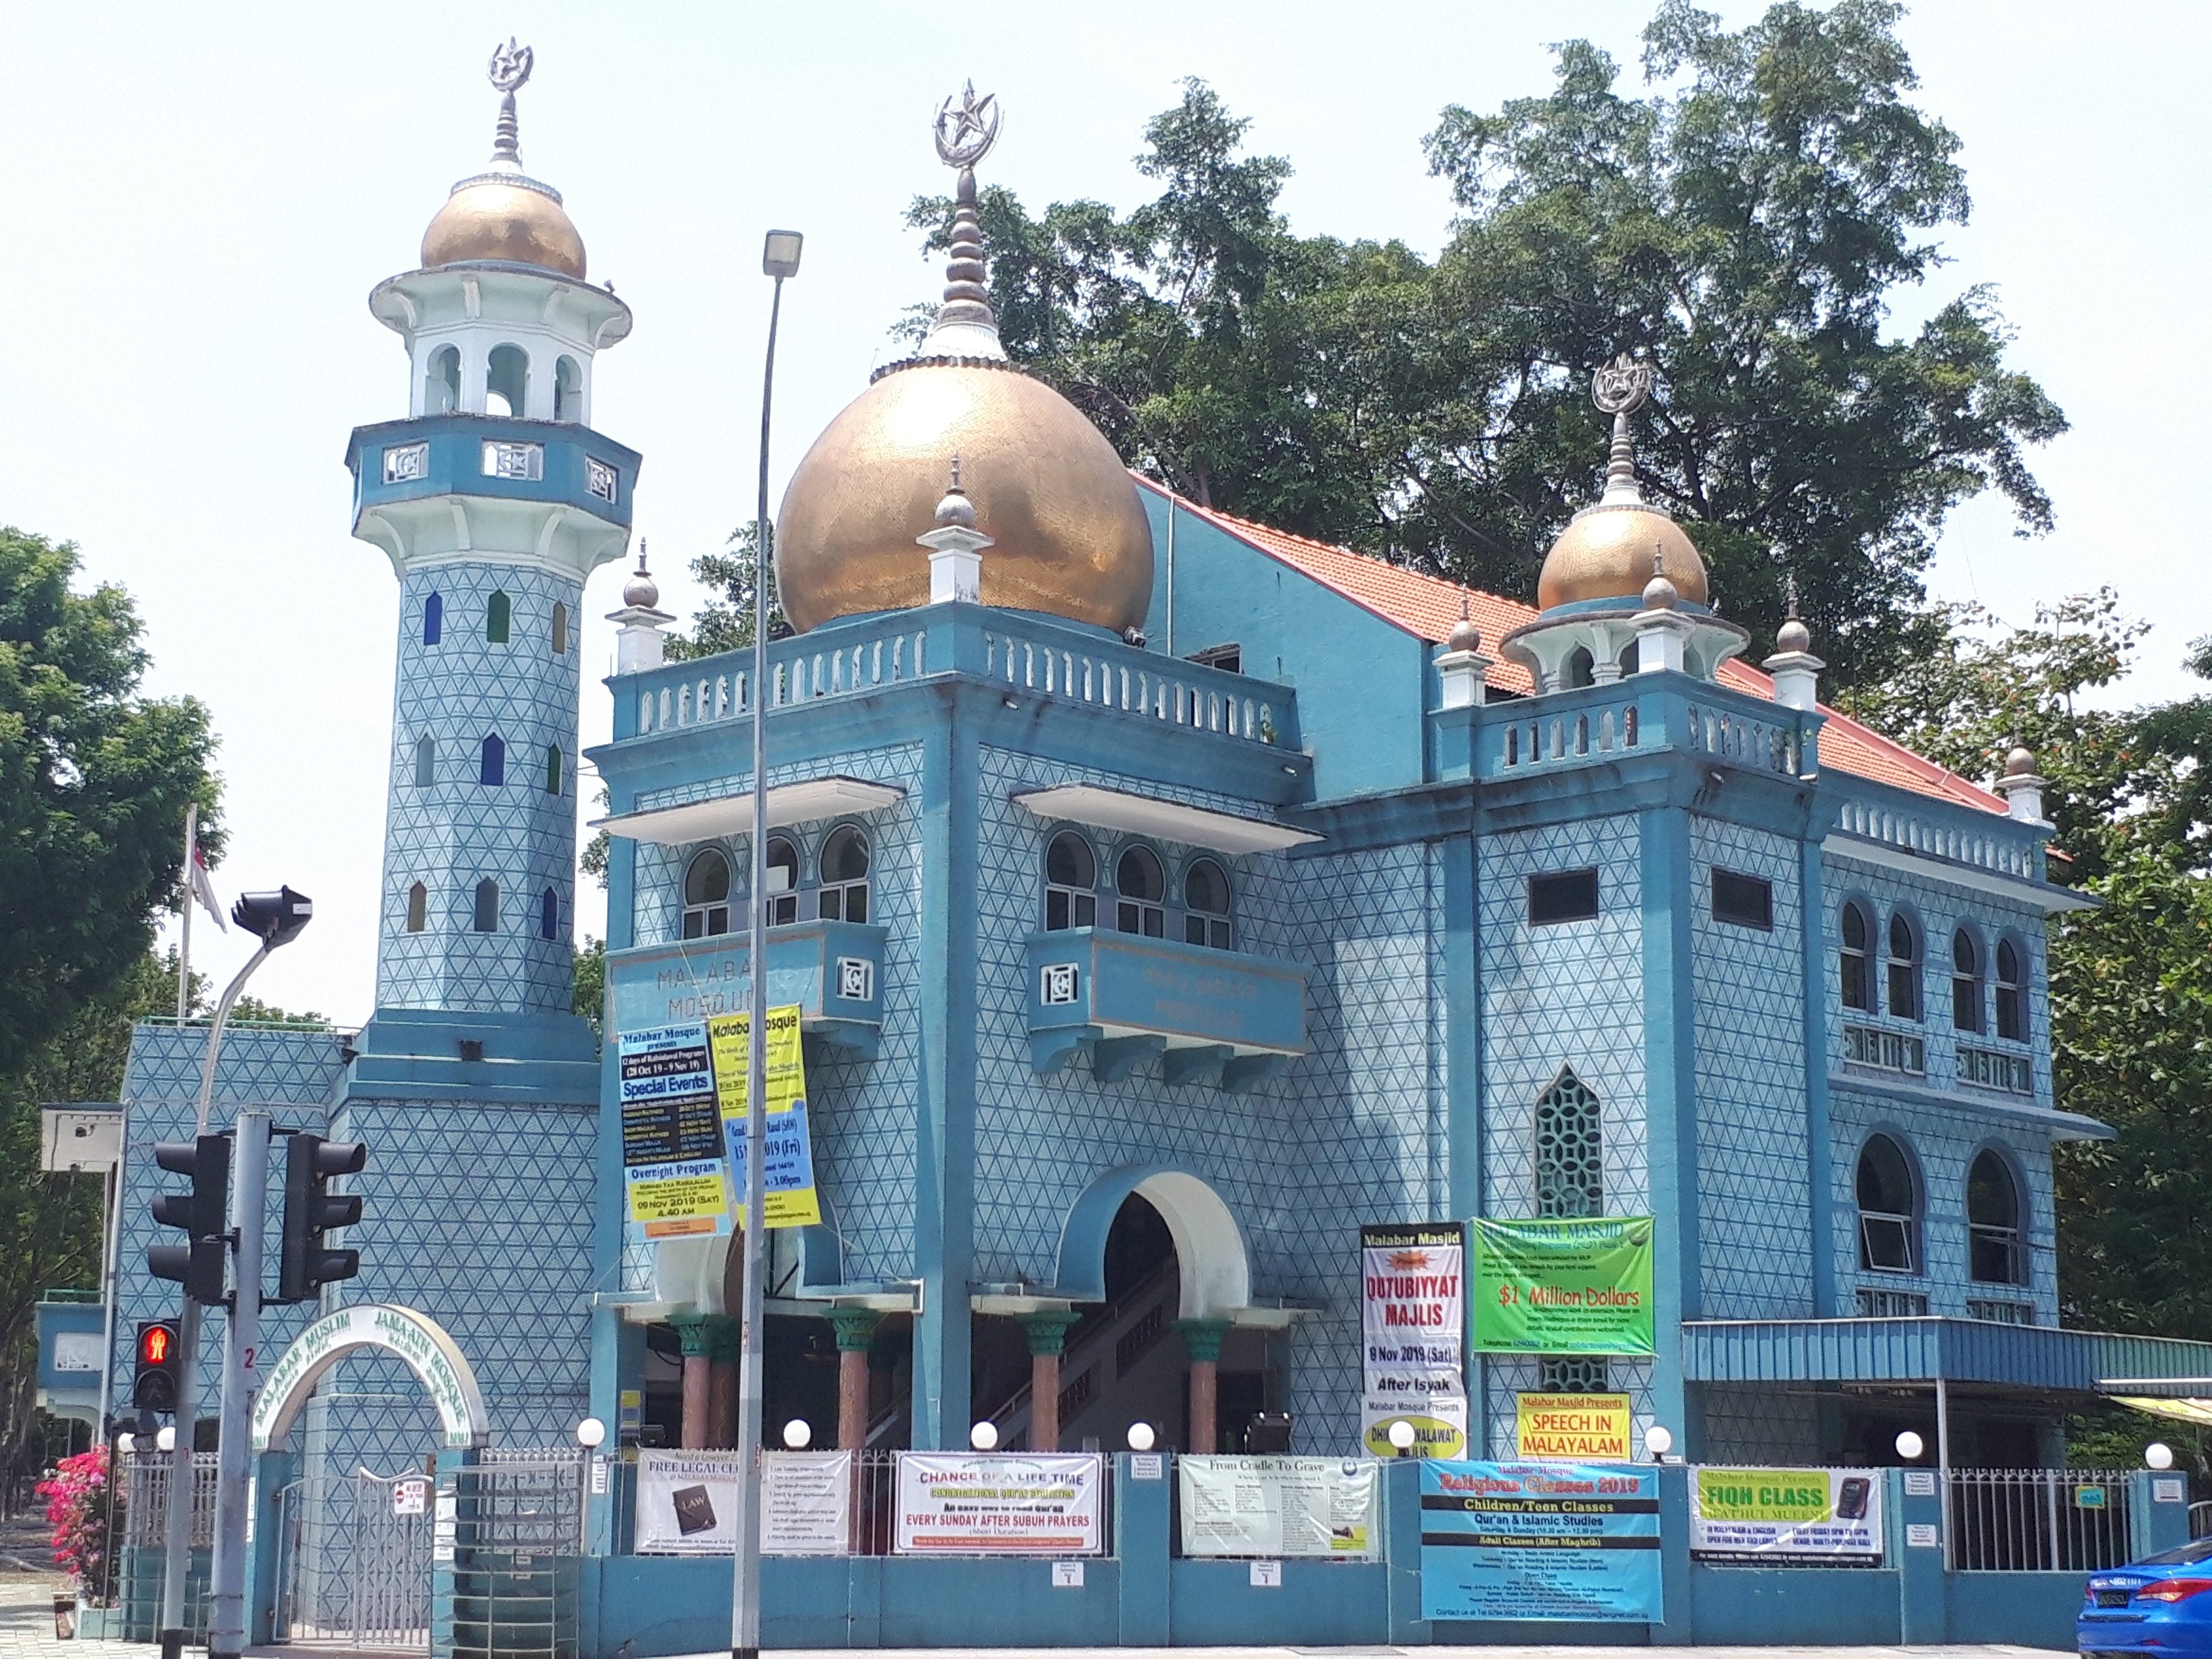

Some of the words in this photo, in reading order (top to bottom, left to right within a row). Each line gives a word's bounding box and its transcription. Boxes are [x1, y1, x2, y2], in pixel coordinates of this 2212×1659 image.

[657, 958, 750, 990] MALABA
[714, 1021, 750, 1038] Malaba
[765, 1015, 797, 1033] osque
[623, 1032, 662, 1044] Malabar
[665, 1027, 701, 1039] Mosque
[623, 1078, 666, 1099] Special
[668, 1075, 708, 1092] Events
[765, 1141, 779, 1156] 019
[632, 1166, 673, 1179] Overnight
[677, 1163, 716, 1176] Program
[649, 1200, 667, 1208] NOV
[670, 1197, 695, 1206] 2019
[697, 1195, 719, 1205] (SAT)
[1364, 1233, 1416, 1246] Malabar
[1418, 1231, 1460, 1246] Masjid
[1567, 1223, 1624, 1239] MASJID
[1366, 1275, 1458, 1300] QUTUBIYYAT
[1498, 1284, 1519, 1307] $1
[1529, 1286, 1582, 1306] Million
[1586, 1286, 1640, 1306] Dollars
[1385, 1303, 1442, 1326] MAJLIS
[245, 1348, 253, 1368] 2
[1378, 1346, 1398, 1361] Nov
[1400, 1345, 1425, 1362] 2019
[1427, 1346, 1452, 1366] (Sat)
[255, 1347, 302, 1427] MALABAR
[305, 1312, 351, 1351] MUSLIM
[431, 1351, 466, 1427] MOSQUE
[1378, 1377, 1411, 1390] After
[1415, 1377, 1450, 1393] Isyak
[1368, 1401, 1395, 1411] Malabar
[1397, 1401, 1425, 1413] Mosque
[1427, 1401, 1459, 1412] Presents
[1523, 1397, 1555, 1407] Malabar
[1559, 1397, 1584, 1408] Masjid
[1586, 1397, 1622, 1408] Presents
[1532, 1414, 1590, 1431] SPEECH
[1596, 1415, 1612, 1431] IN
[1523, 1436, 1623, 1454] MALAYALAM
[649, 1461, 678, 1472] FREE
[681, 1462, 718, 1473] LEGAL
[721, 1463, 738, 1473] CLI
[1210, 1459, 1237, 1471] From
[1240, 1459, 1273, 1471] Cradle
[1276, 1460, 1291, 1471] To
[1294, 1460, 1325, 1472] Grave
[1538, 1466, 1574, 1476] Mosque
[920, 1472, 977, 1484] CHANCE
[1018, 1473, 1046, 1483] LIFE
[1050, 1473, 1084, 1486] TIME
[1439, 1473, 1521, 1496] Religious
[1525, 1475, 1594, 1494] Classes
[1597, 1476, 1639, 1494] 2019
[682, 1495, 705, 1510] LAW
[1706, 1486, 1753, 1507] FIQH
[1759, 1486, 1824, 1507] CLASS
[1562, 1501, 1614, 1512] Classes
[907, 1514, 937, 1525] EVERY
[940, 1514, 978, 1525] SUNDAY
[981, 1515, 1010, 1526] AFTER
[1013, 1515, 1045, 1526] SUBUH
[1048, 1515, 1089, 1528] PRAYERS
[1475, 1513, 1509, 1524] Qur'an
[1512, 1515, 1519, 1524] &
[1522, 1515, 1559, 1525] Islamic
[1563, 1515, 1603, 1525] Studies
[1502, 1537, 1534, 1545] Classes
